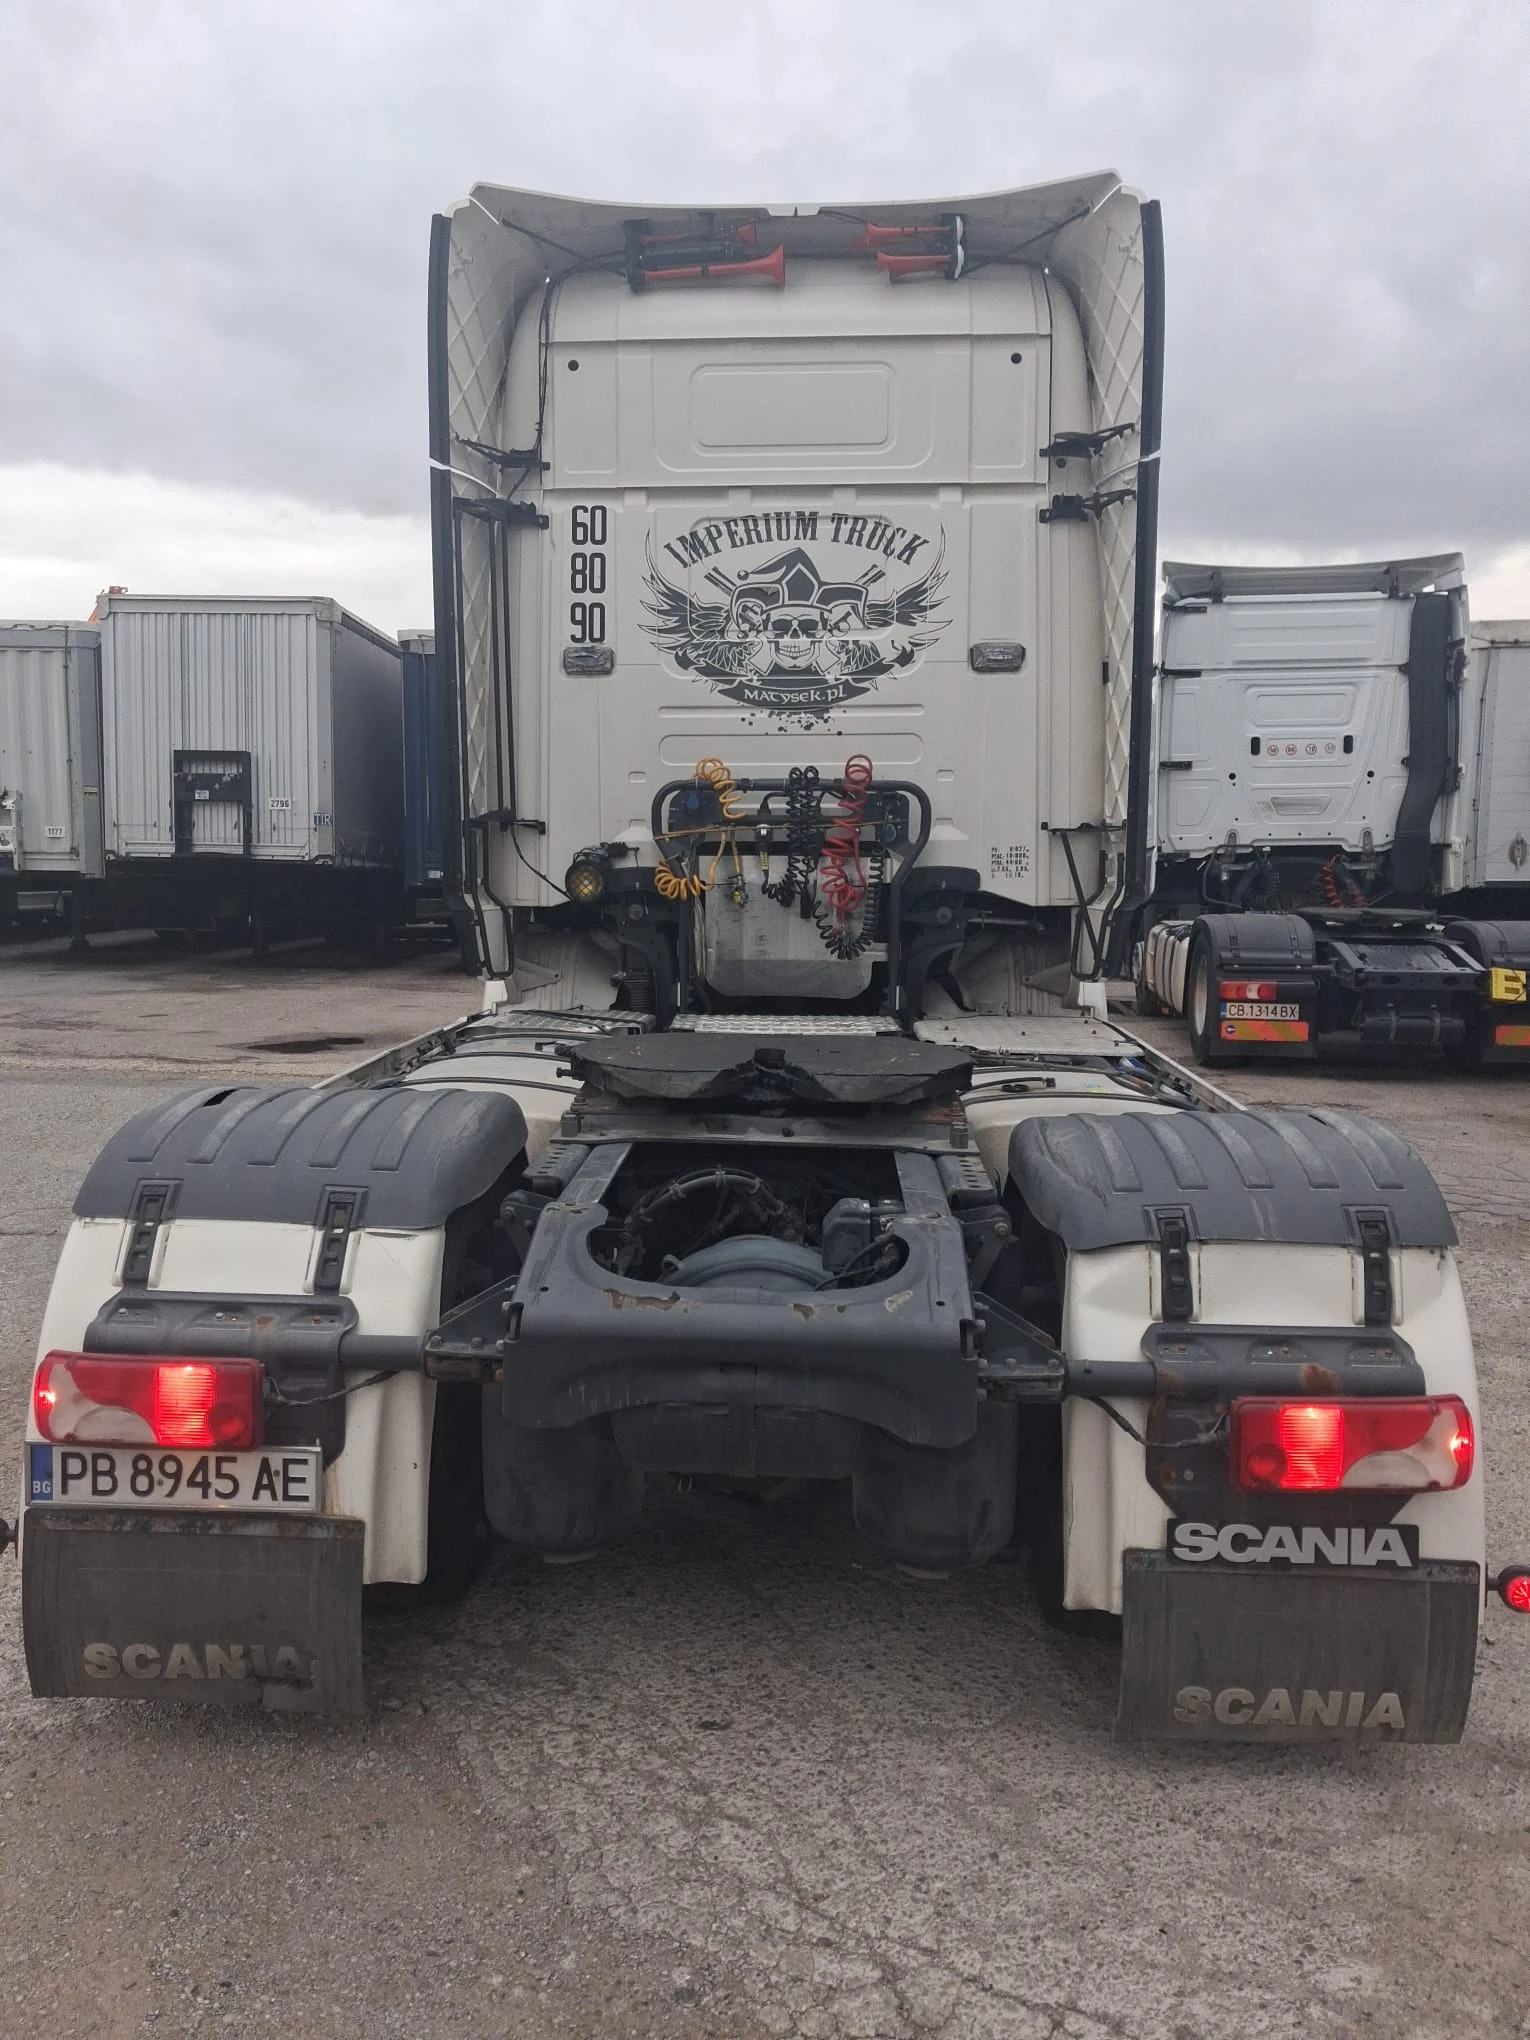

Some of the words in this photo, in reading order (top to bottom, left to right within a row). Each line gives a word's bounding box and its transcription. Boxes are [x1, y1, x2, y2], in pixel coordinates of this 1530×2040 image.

[571, 505, 607, 545] 60
[663, 510, 820, 569] IMPERIUM
[831, 512, 930, 566] TRUCK
[570, 552, 606, 594] 80
[570, 602, 606, 643] 90
[270, 799, 290, 808] 2796
[314, 813, 332, 826] TIR
[1228, 1004, 1245, 1017] CB
[1249, 1005, 1278, 1018] 1314
[1280, 1006, 1297, 1018] BX
[32, 1480, 51, 1494] BG
[60, 1451, 119, 1497] PB
[129, 1453, 241, 1500] 8945
[251, 1456, 310, 1503] AE
[1173, 1522, 1412, 1567] SCANIA
[1173, 1686, 1406, 1729] SCANIA
